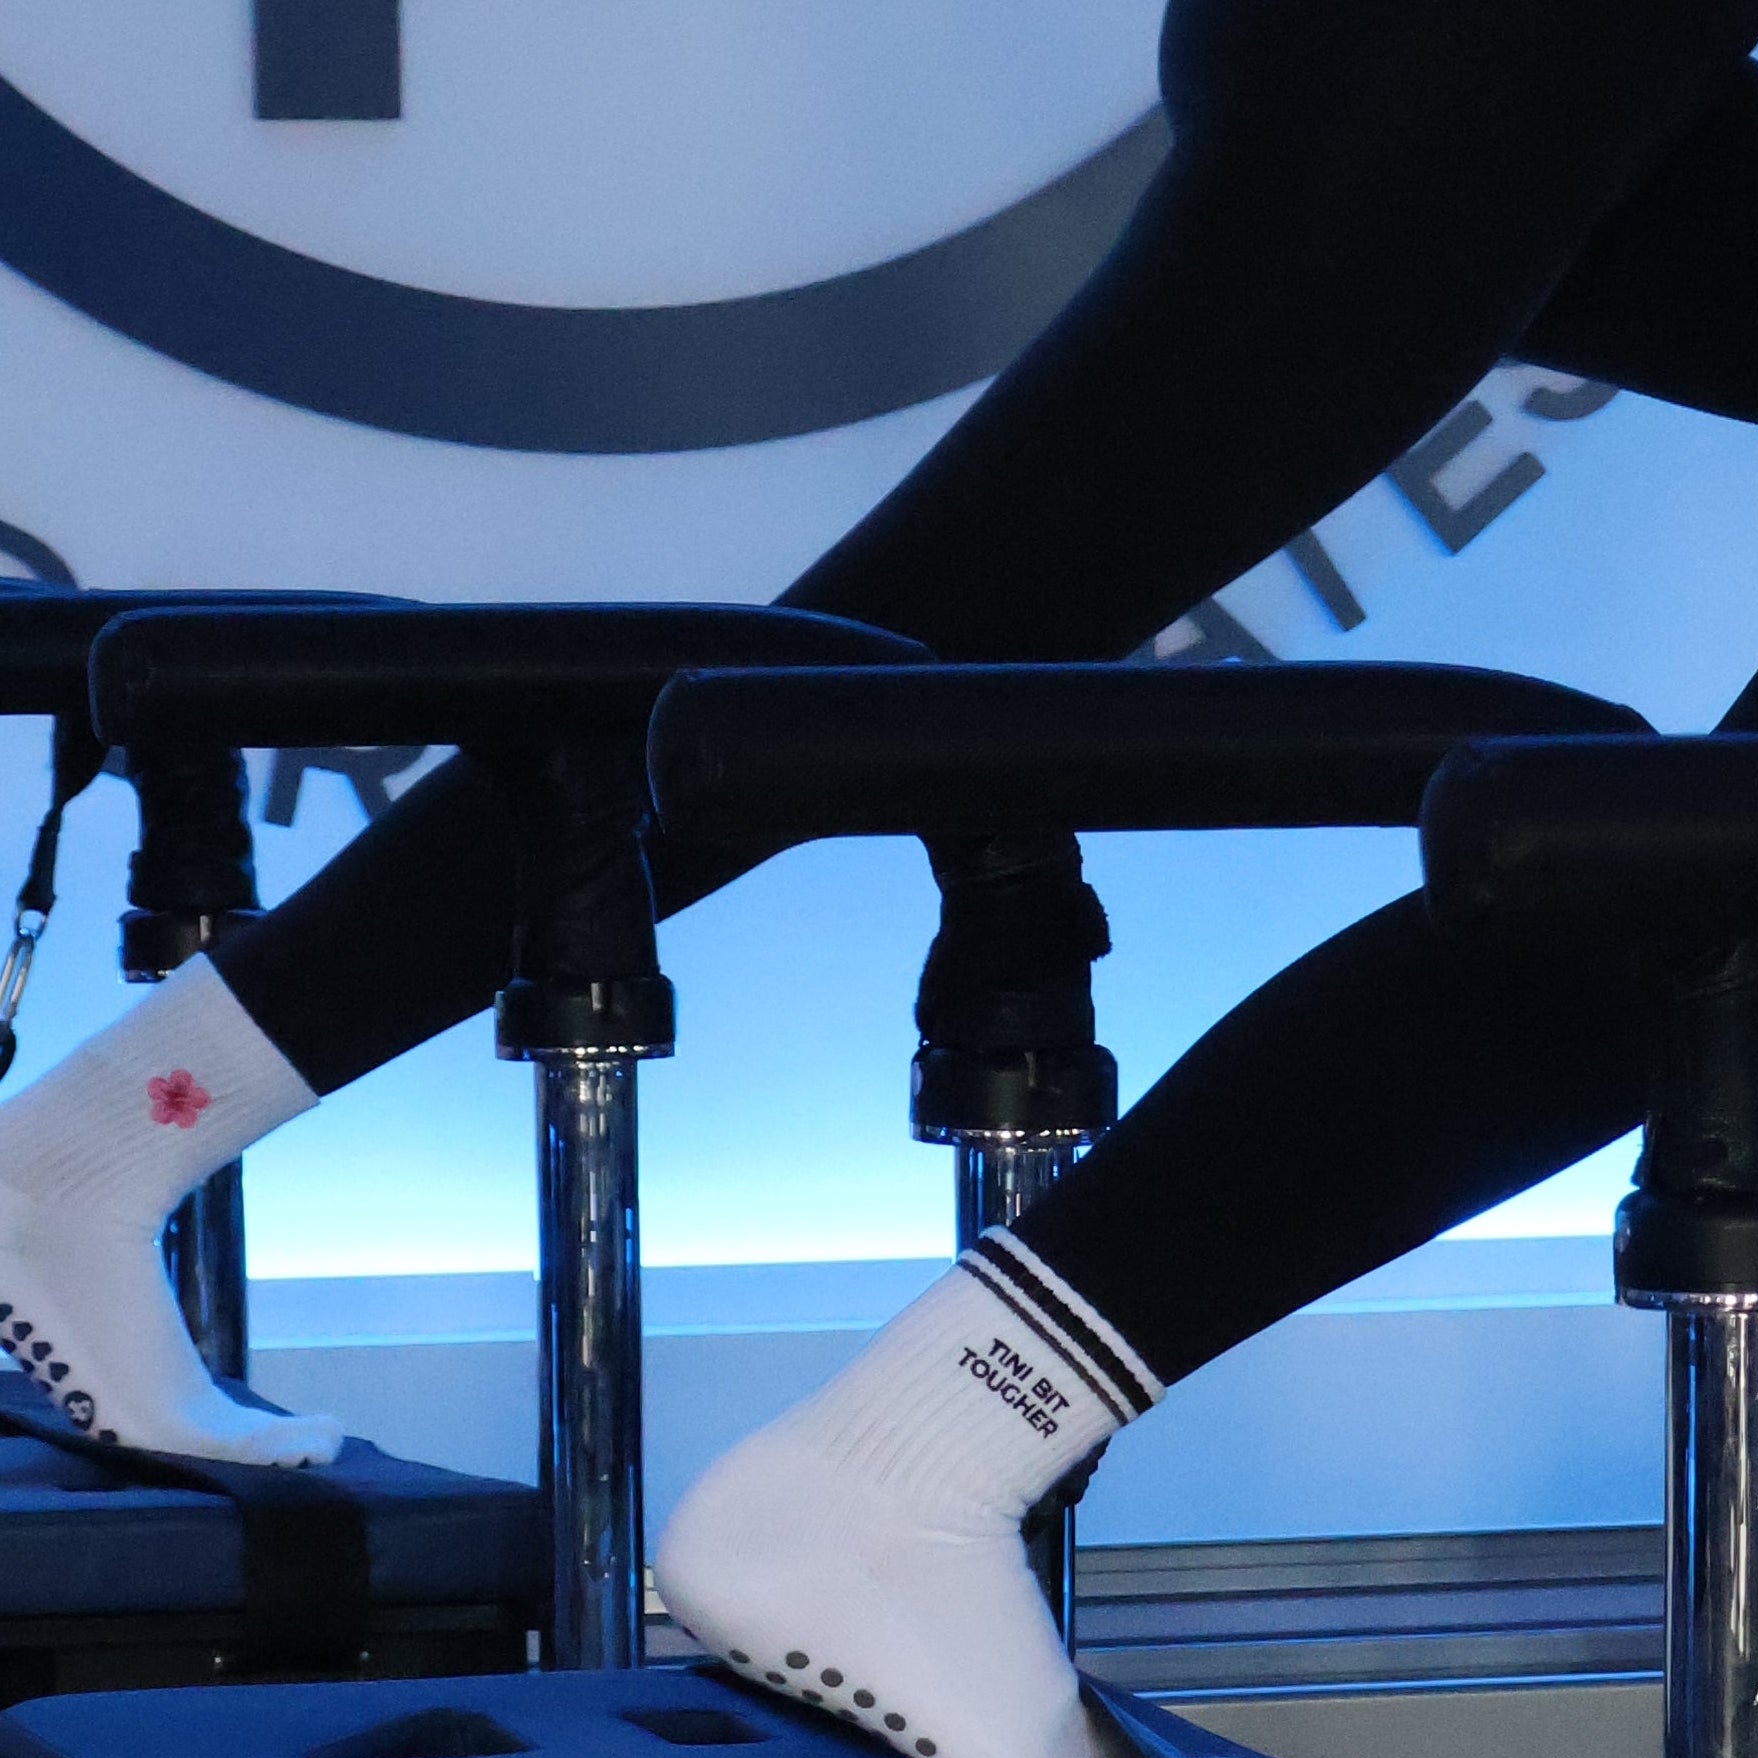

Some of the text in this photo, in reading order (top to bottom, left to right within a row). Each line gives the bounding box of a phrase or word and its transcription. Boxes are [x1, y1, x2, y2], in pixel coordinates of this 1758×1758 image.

[958, 1347, 1058, 1439] TOUGHER
[988, 1338, 1070, 1413] TINI BIT
